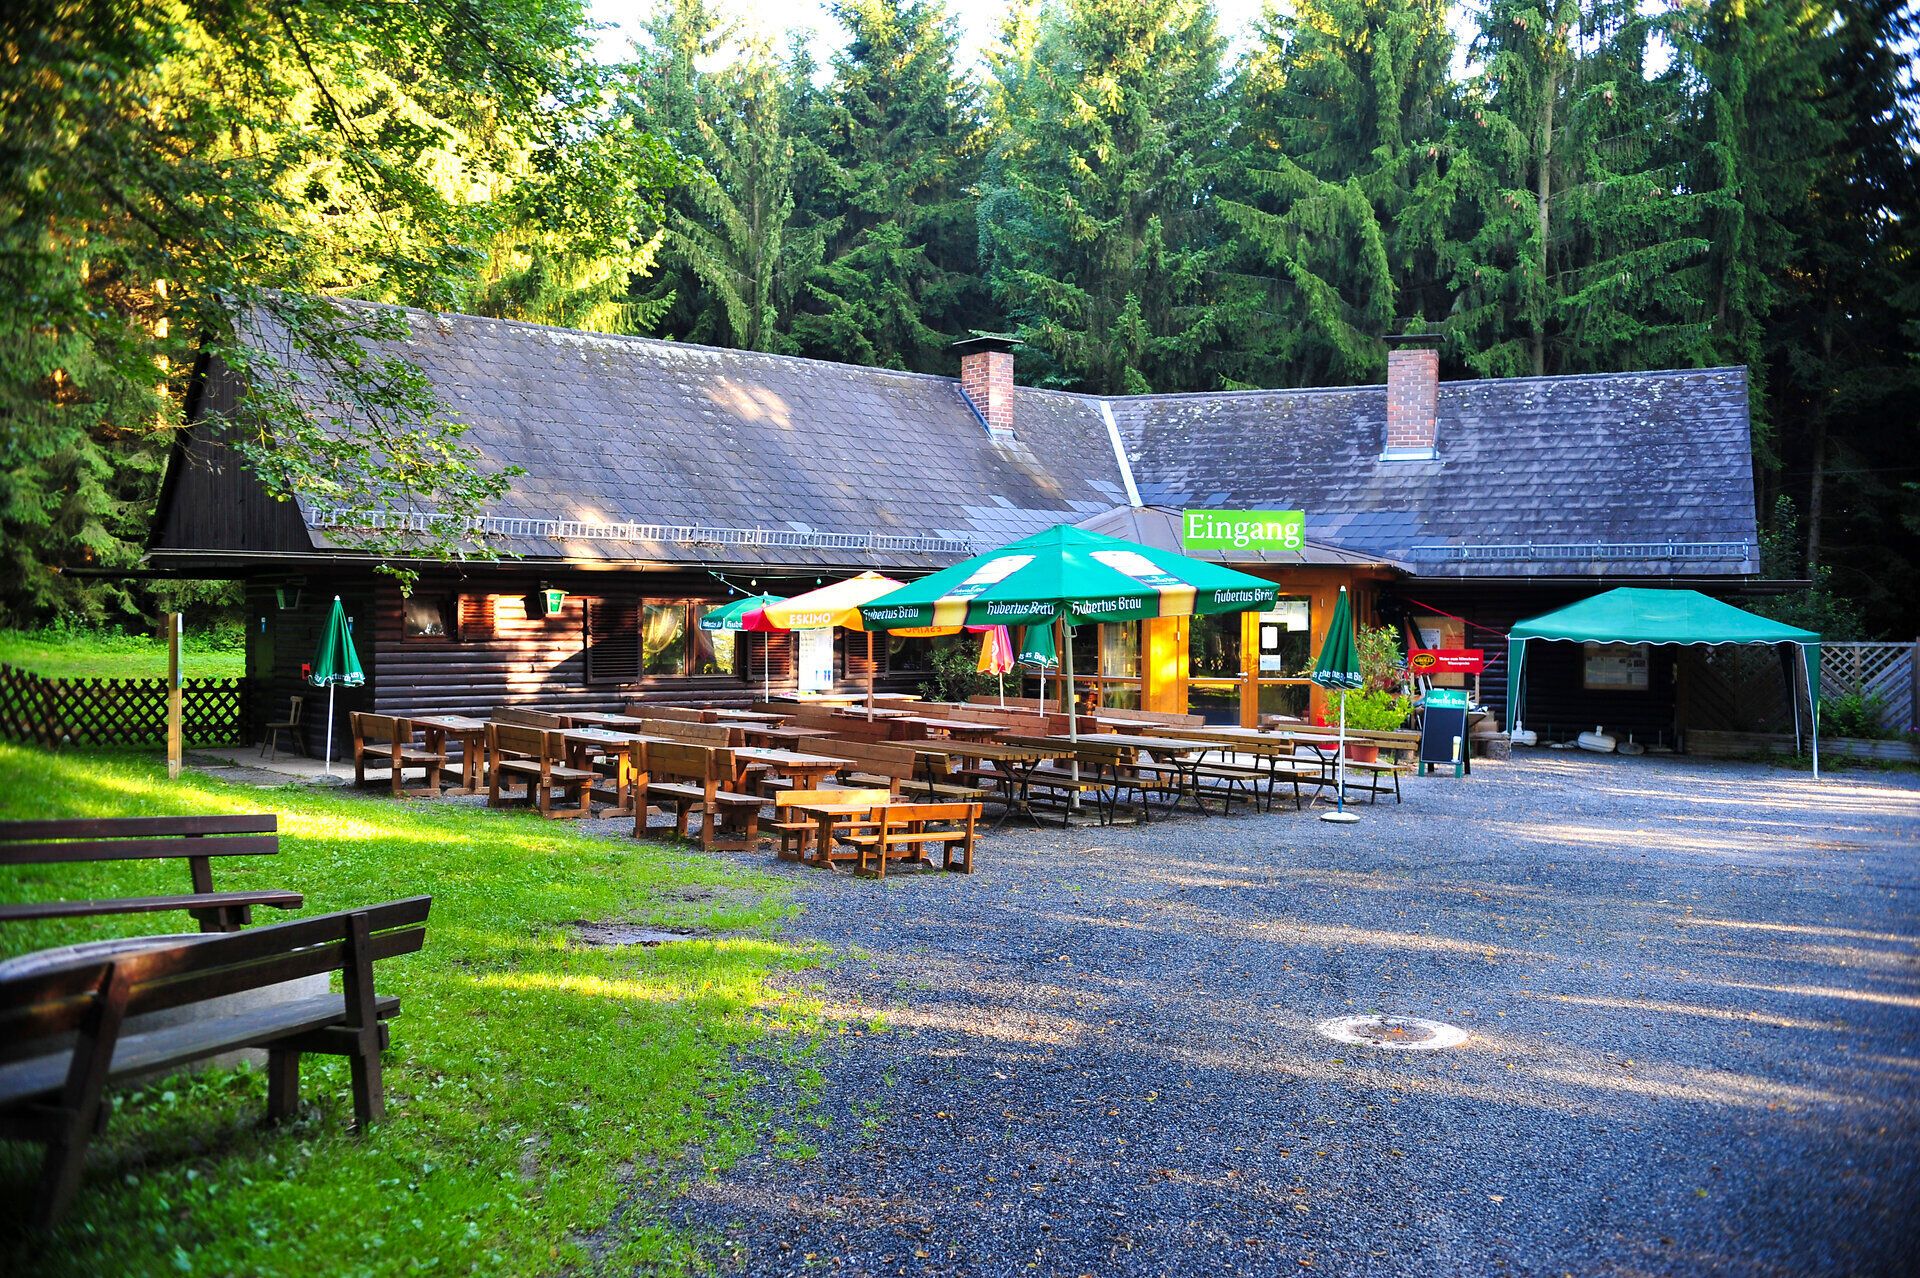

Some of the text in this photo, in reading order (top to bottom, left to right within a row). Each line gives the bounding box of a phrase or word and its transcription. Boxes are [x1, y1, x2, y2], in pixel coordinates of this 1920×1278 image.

[1187, 514, 1301, 549] Eingang
[1214, 588, 1253, 604] Hubertus
[863, 604, 919, 623] Hubertus Bräu
[986, 601, 1055, 615] Hubertus Bräu
[1072, 596, 1142, 615] Hubertus Bräu
[789, 613, 831, 625] ESKIMO
